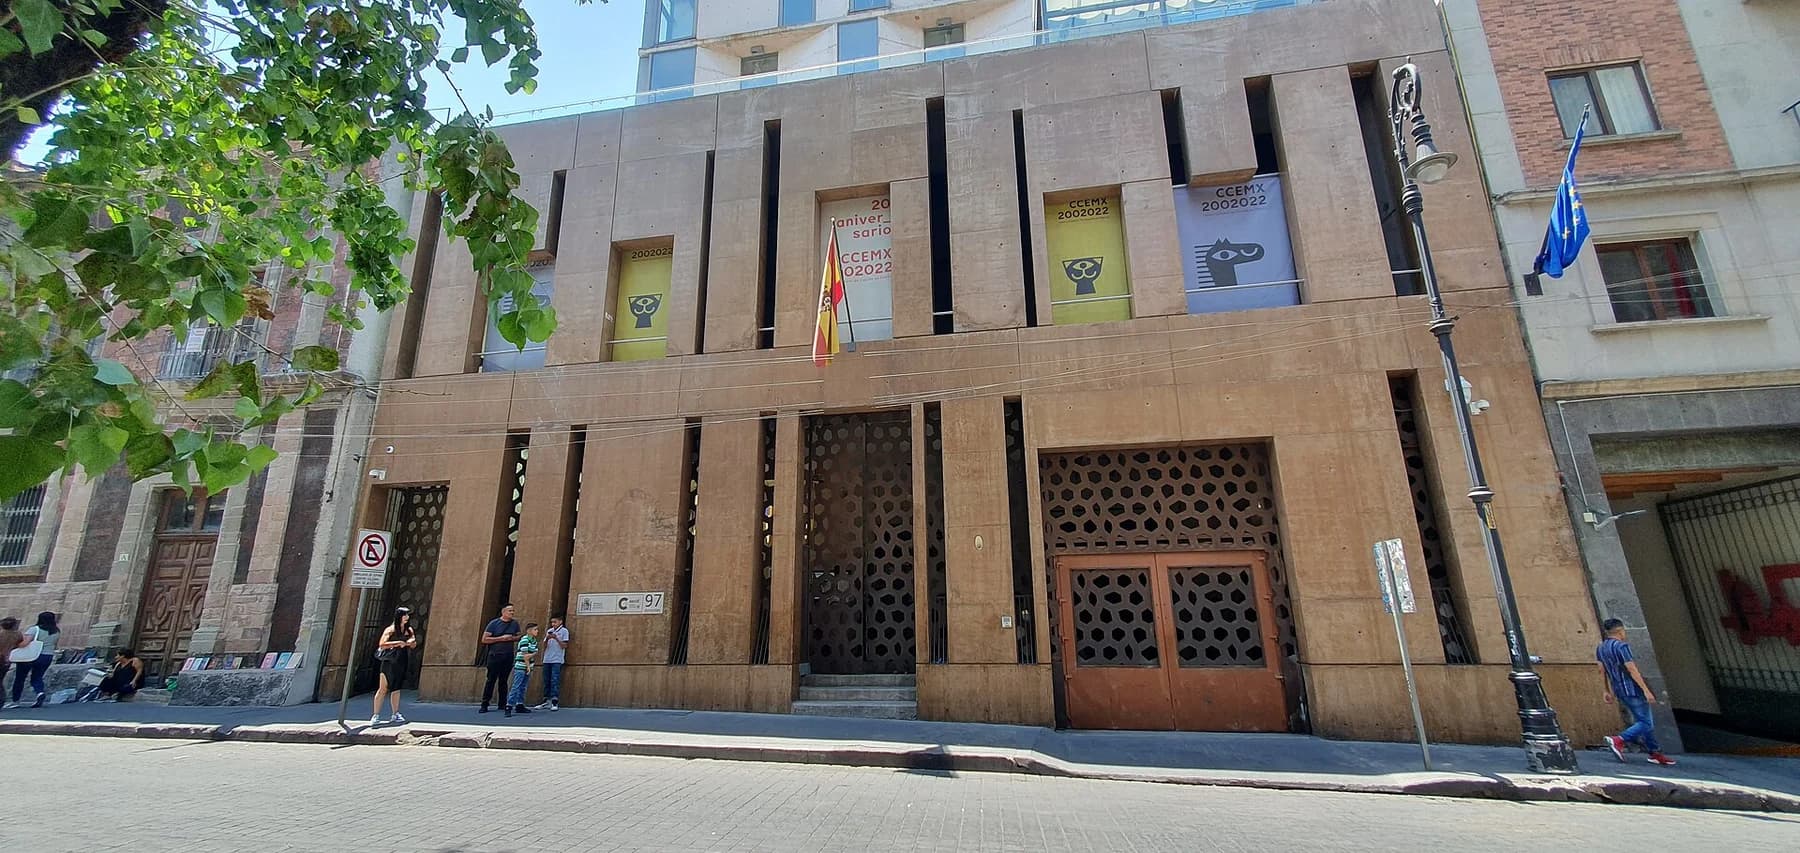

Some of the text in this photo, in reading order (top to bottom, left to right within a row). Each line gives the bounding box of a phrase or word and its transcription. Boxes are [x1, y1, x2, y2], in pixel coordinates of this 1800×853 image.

[1216, 184, 1265, 198] CCEMX
[872, 199, 890, 210] 20
[1069, 196, 1108, 208] CCEMX
[1202, 195, 1267, 212] 2002022
[1058, 207, 1109, 219] 2002022
[853, 225, 892, 238] sario
[841, 248, 892, 263] CCEMX
[844, 262, 892, 277] 02022
[645, 594, 662, 607] 97
